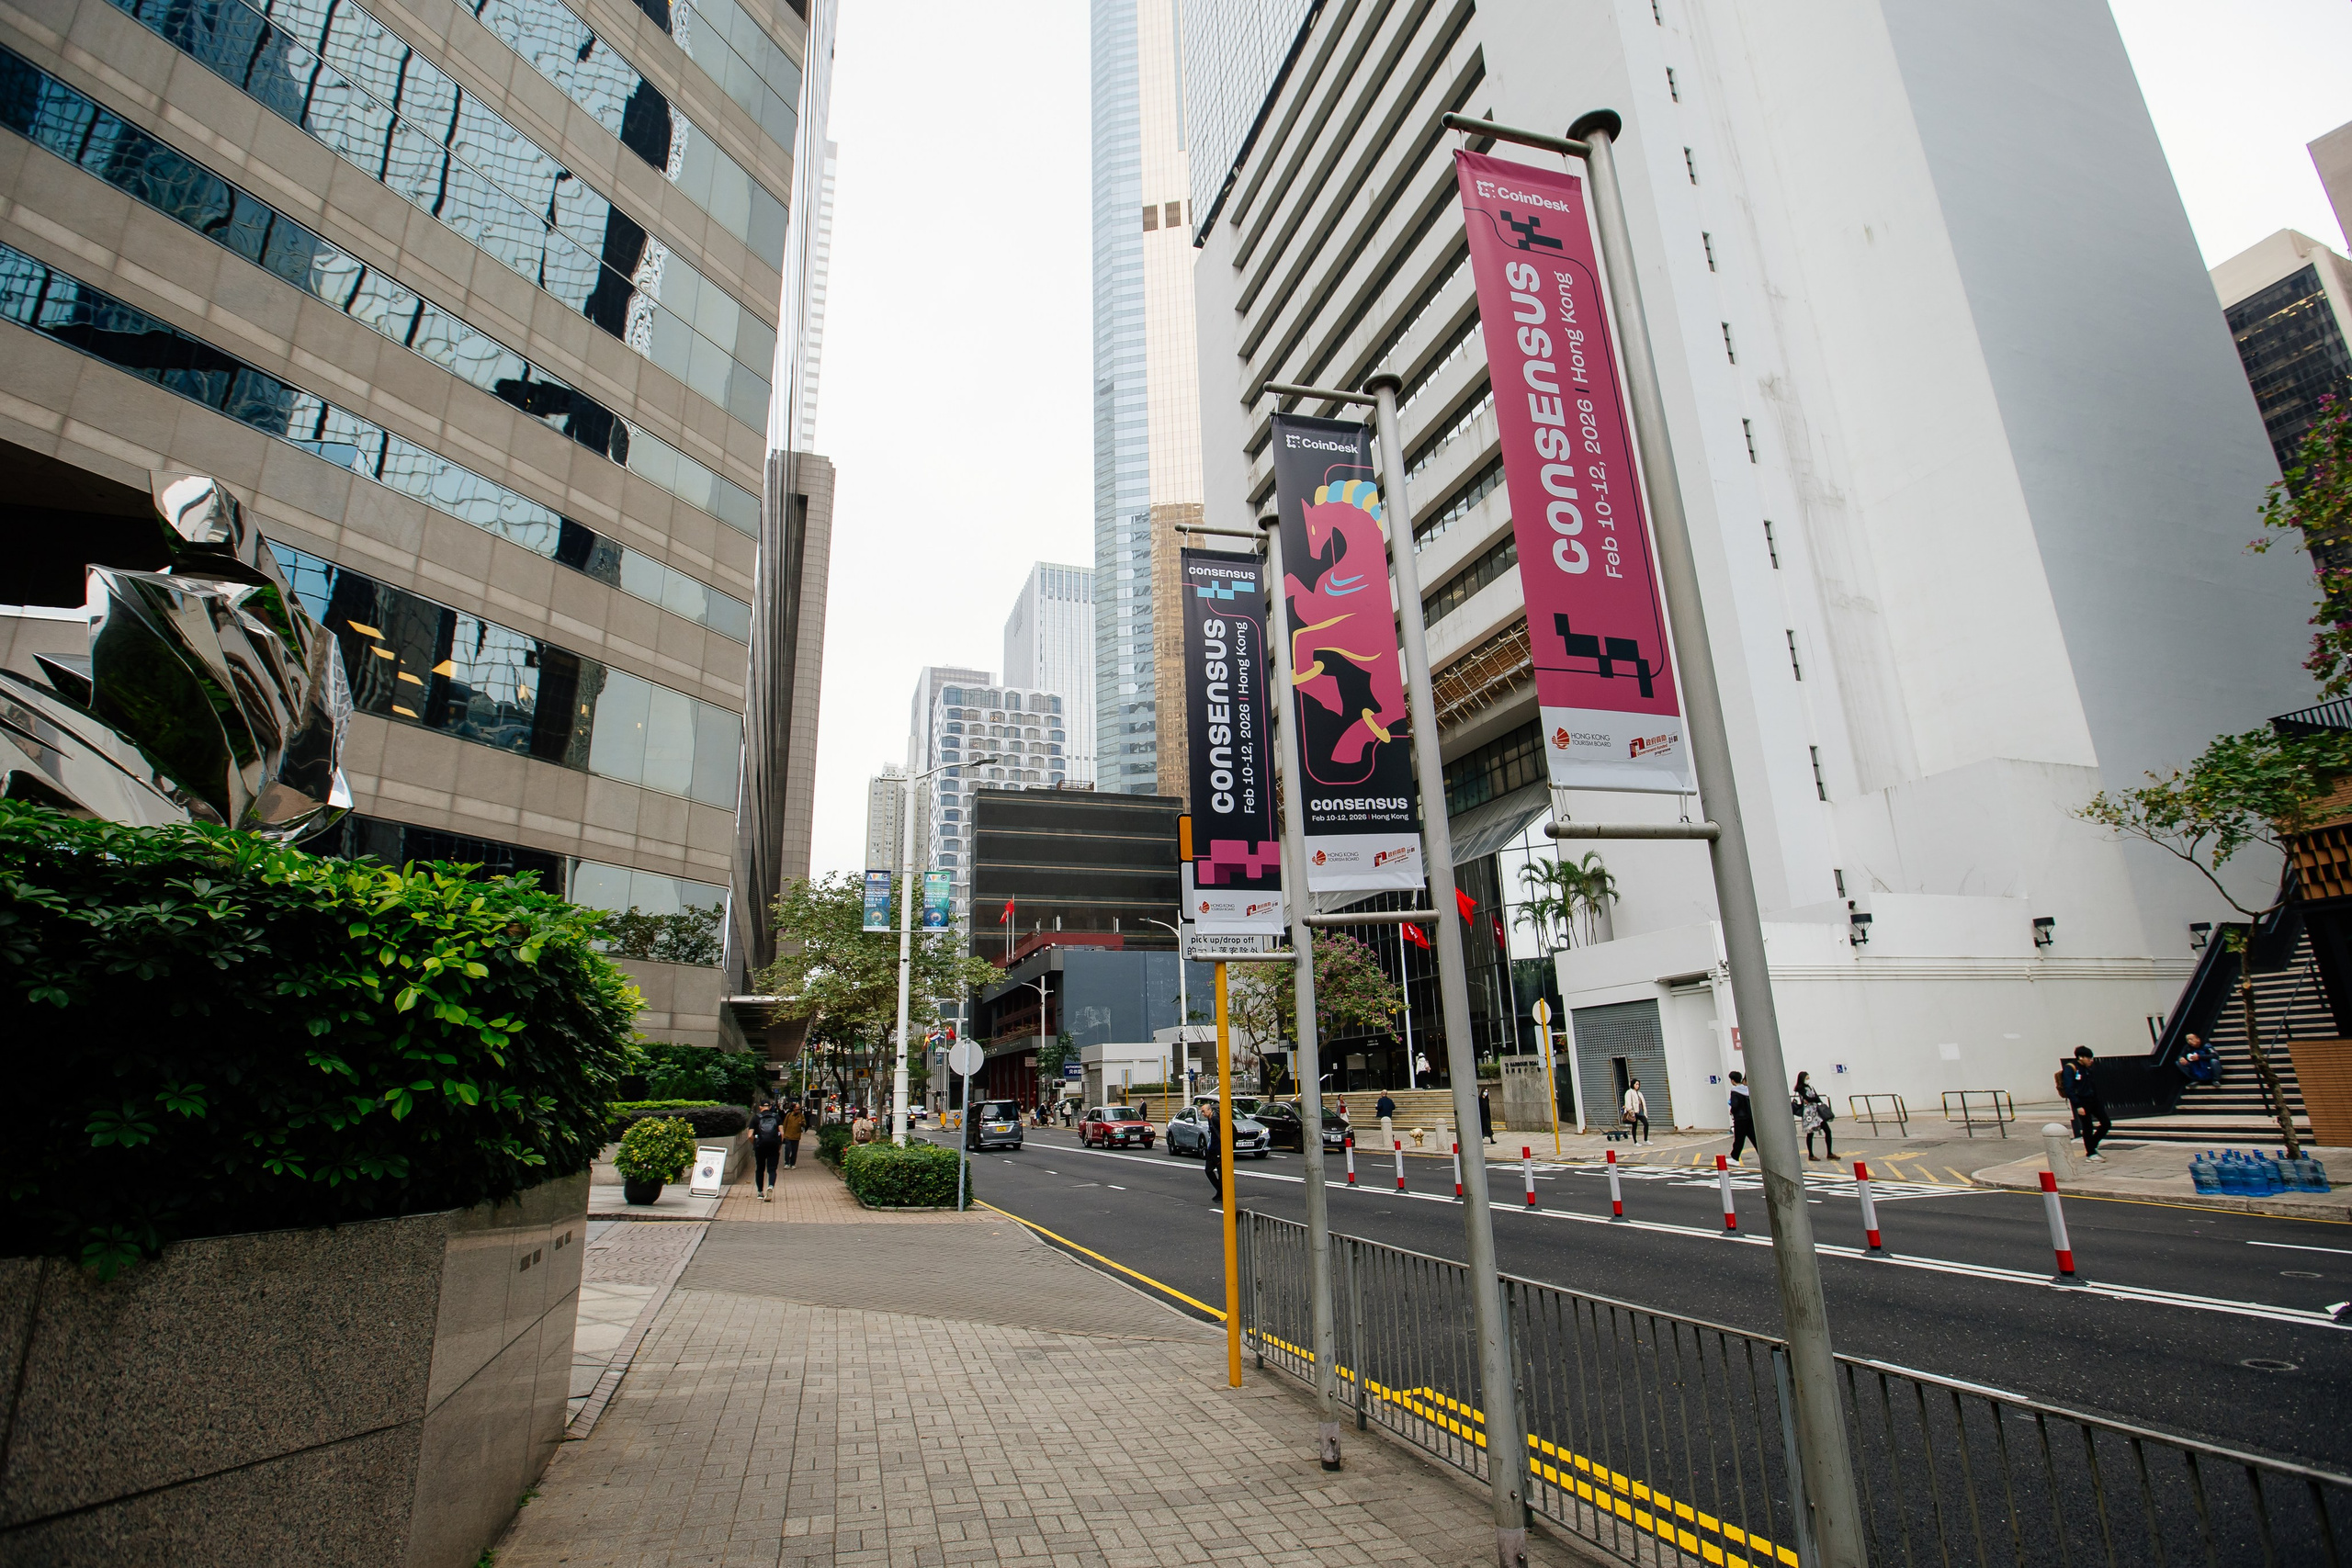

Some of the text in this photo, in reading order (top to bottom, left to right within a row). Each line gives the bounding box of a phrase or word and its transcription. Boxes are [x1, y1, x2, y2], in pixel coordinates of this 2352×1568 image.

[1498, 186, 1570, 213] CoinDesk
[1554, 271, 1577, 323] Kong
[1565, 328, 1589, 384] Hong
[1577, 399, 1601, 455] 2026
[1302, 438, 1359, 454] CoinDesk
[1589, 461, 1615, 531] 10-12,
[1601, 536, 1623, 579] Feb
[1235, 622, 1249, 656] Kong
[1238, 659, 1250, 694] Hong
[1239, 704, 1251, 739] 2026
[1571, 732, 1590, 740] HONG
[1241, 741, 1254, 785] 10-12,
[1243, 788, 1255, 814] Feb
[1191, 935, 1208, 944] pick
[1210, 936, 1241, 944] up/drop
